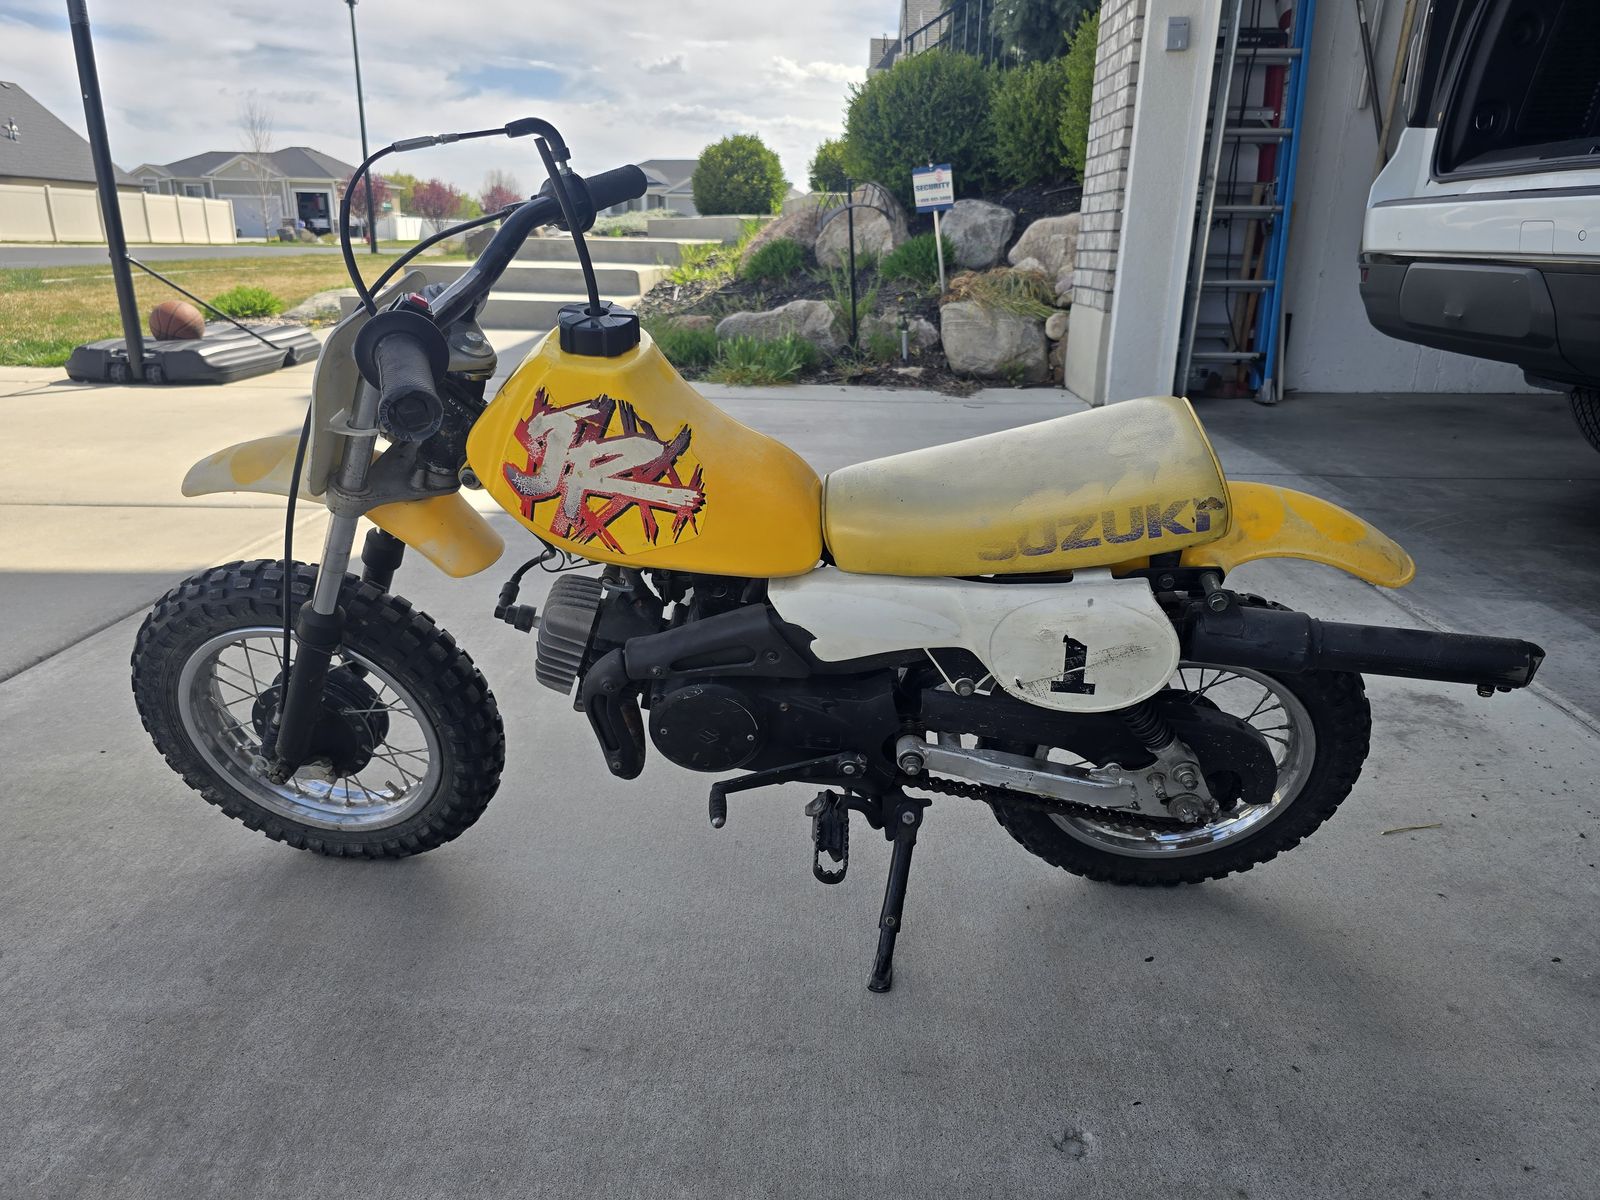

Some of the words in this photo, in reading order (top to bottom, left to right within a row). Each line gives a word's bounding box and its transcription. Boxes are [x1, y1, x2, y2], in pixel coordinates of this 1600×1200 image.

[915, 181, 950, 192] SECURITY
[503, 398, 704, 524] JR
[1050, 634, 1096, 695] 1
